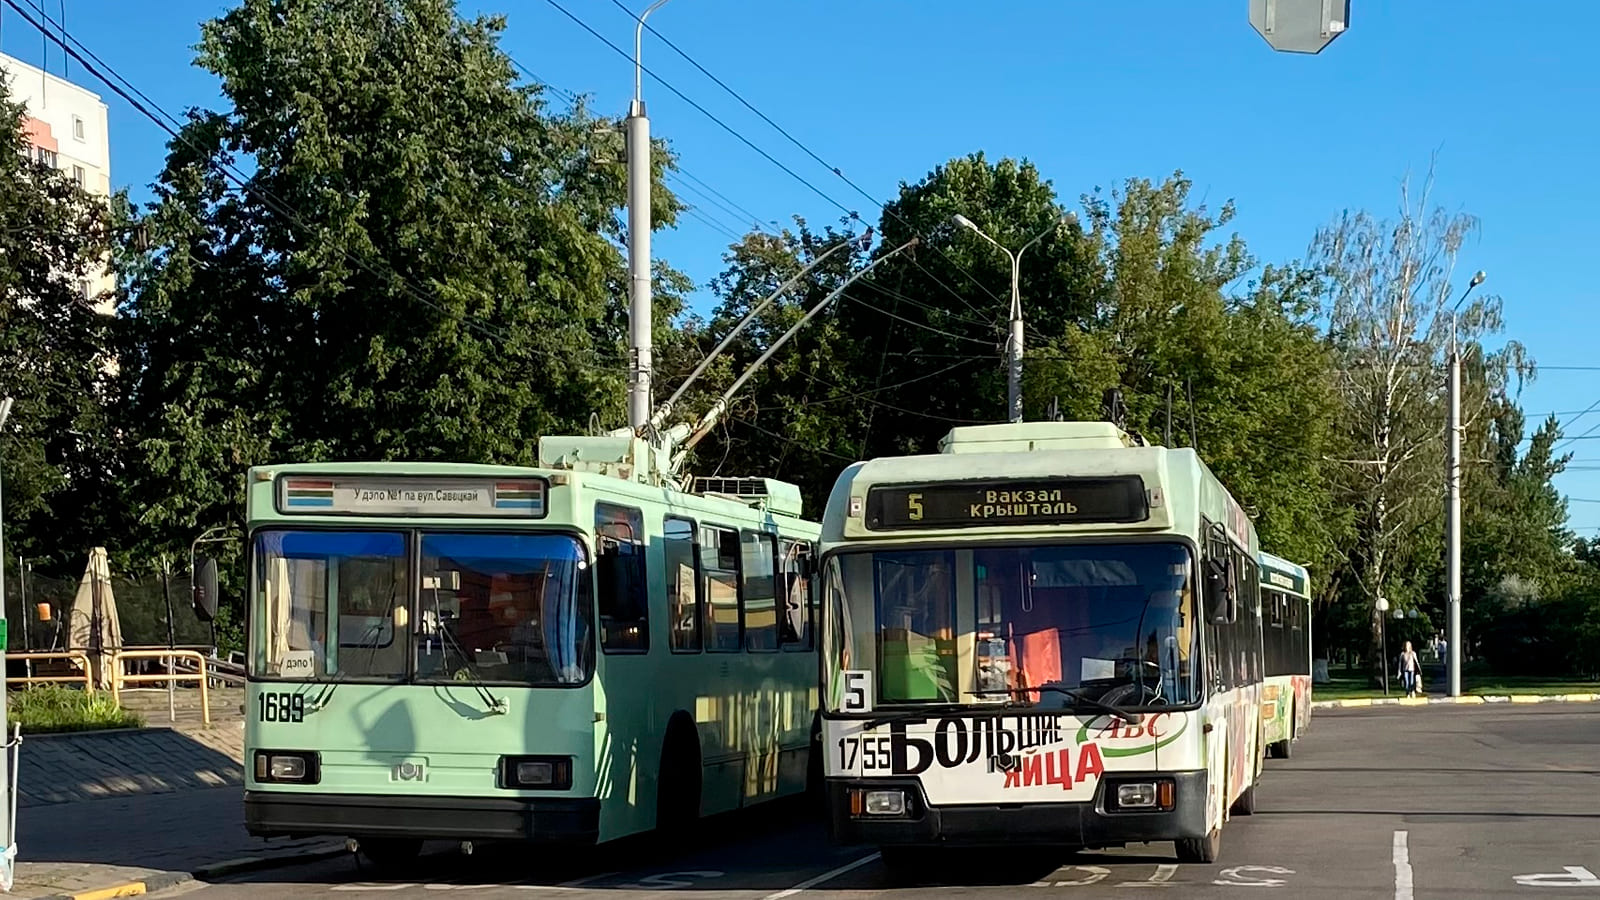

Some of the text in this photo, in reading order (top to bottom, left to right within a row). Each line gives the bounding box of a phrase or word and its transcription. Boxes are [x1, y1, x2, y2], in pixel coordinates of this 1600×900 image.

[354, 488, 361, 499] У
[362, 490, 385, 502] дэпо
[387, 489, 402, 500] №1
[405, 491, 415, 501] па
[908, 493, 924, 521] 5
[986, 489, 1062, 504] Вакзал
[970, 502, 1078, 518] Крышталь
[286, 658, 308, 670] дэпо
[845, 673, 865, 709] 5
[259, 692, 304, 723] 1689
[838, 737, 891, 770] 1755
[1003, 742, 1105, 791] ЯЙЦА
